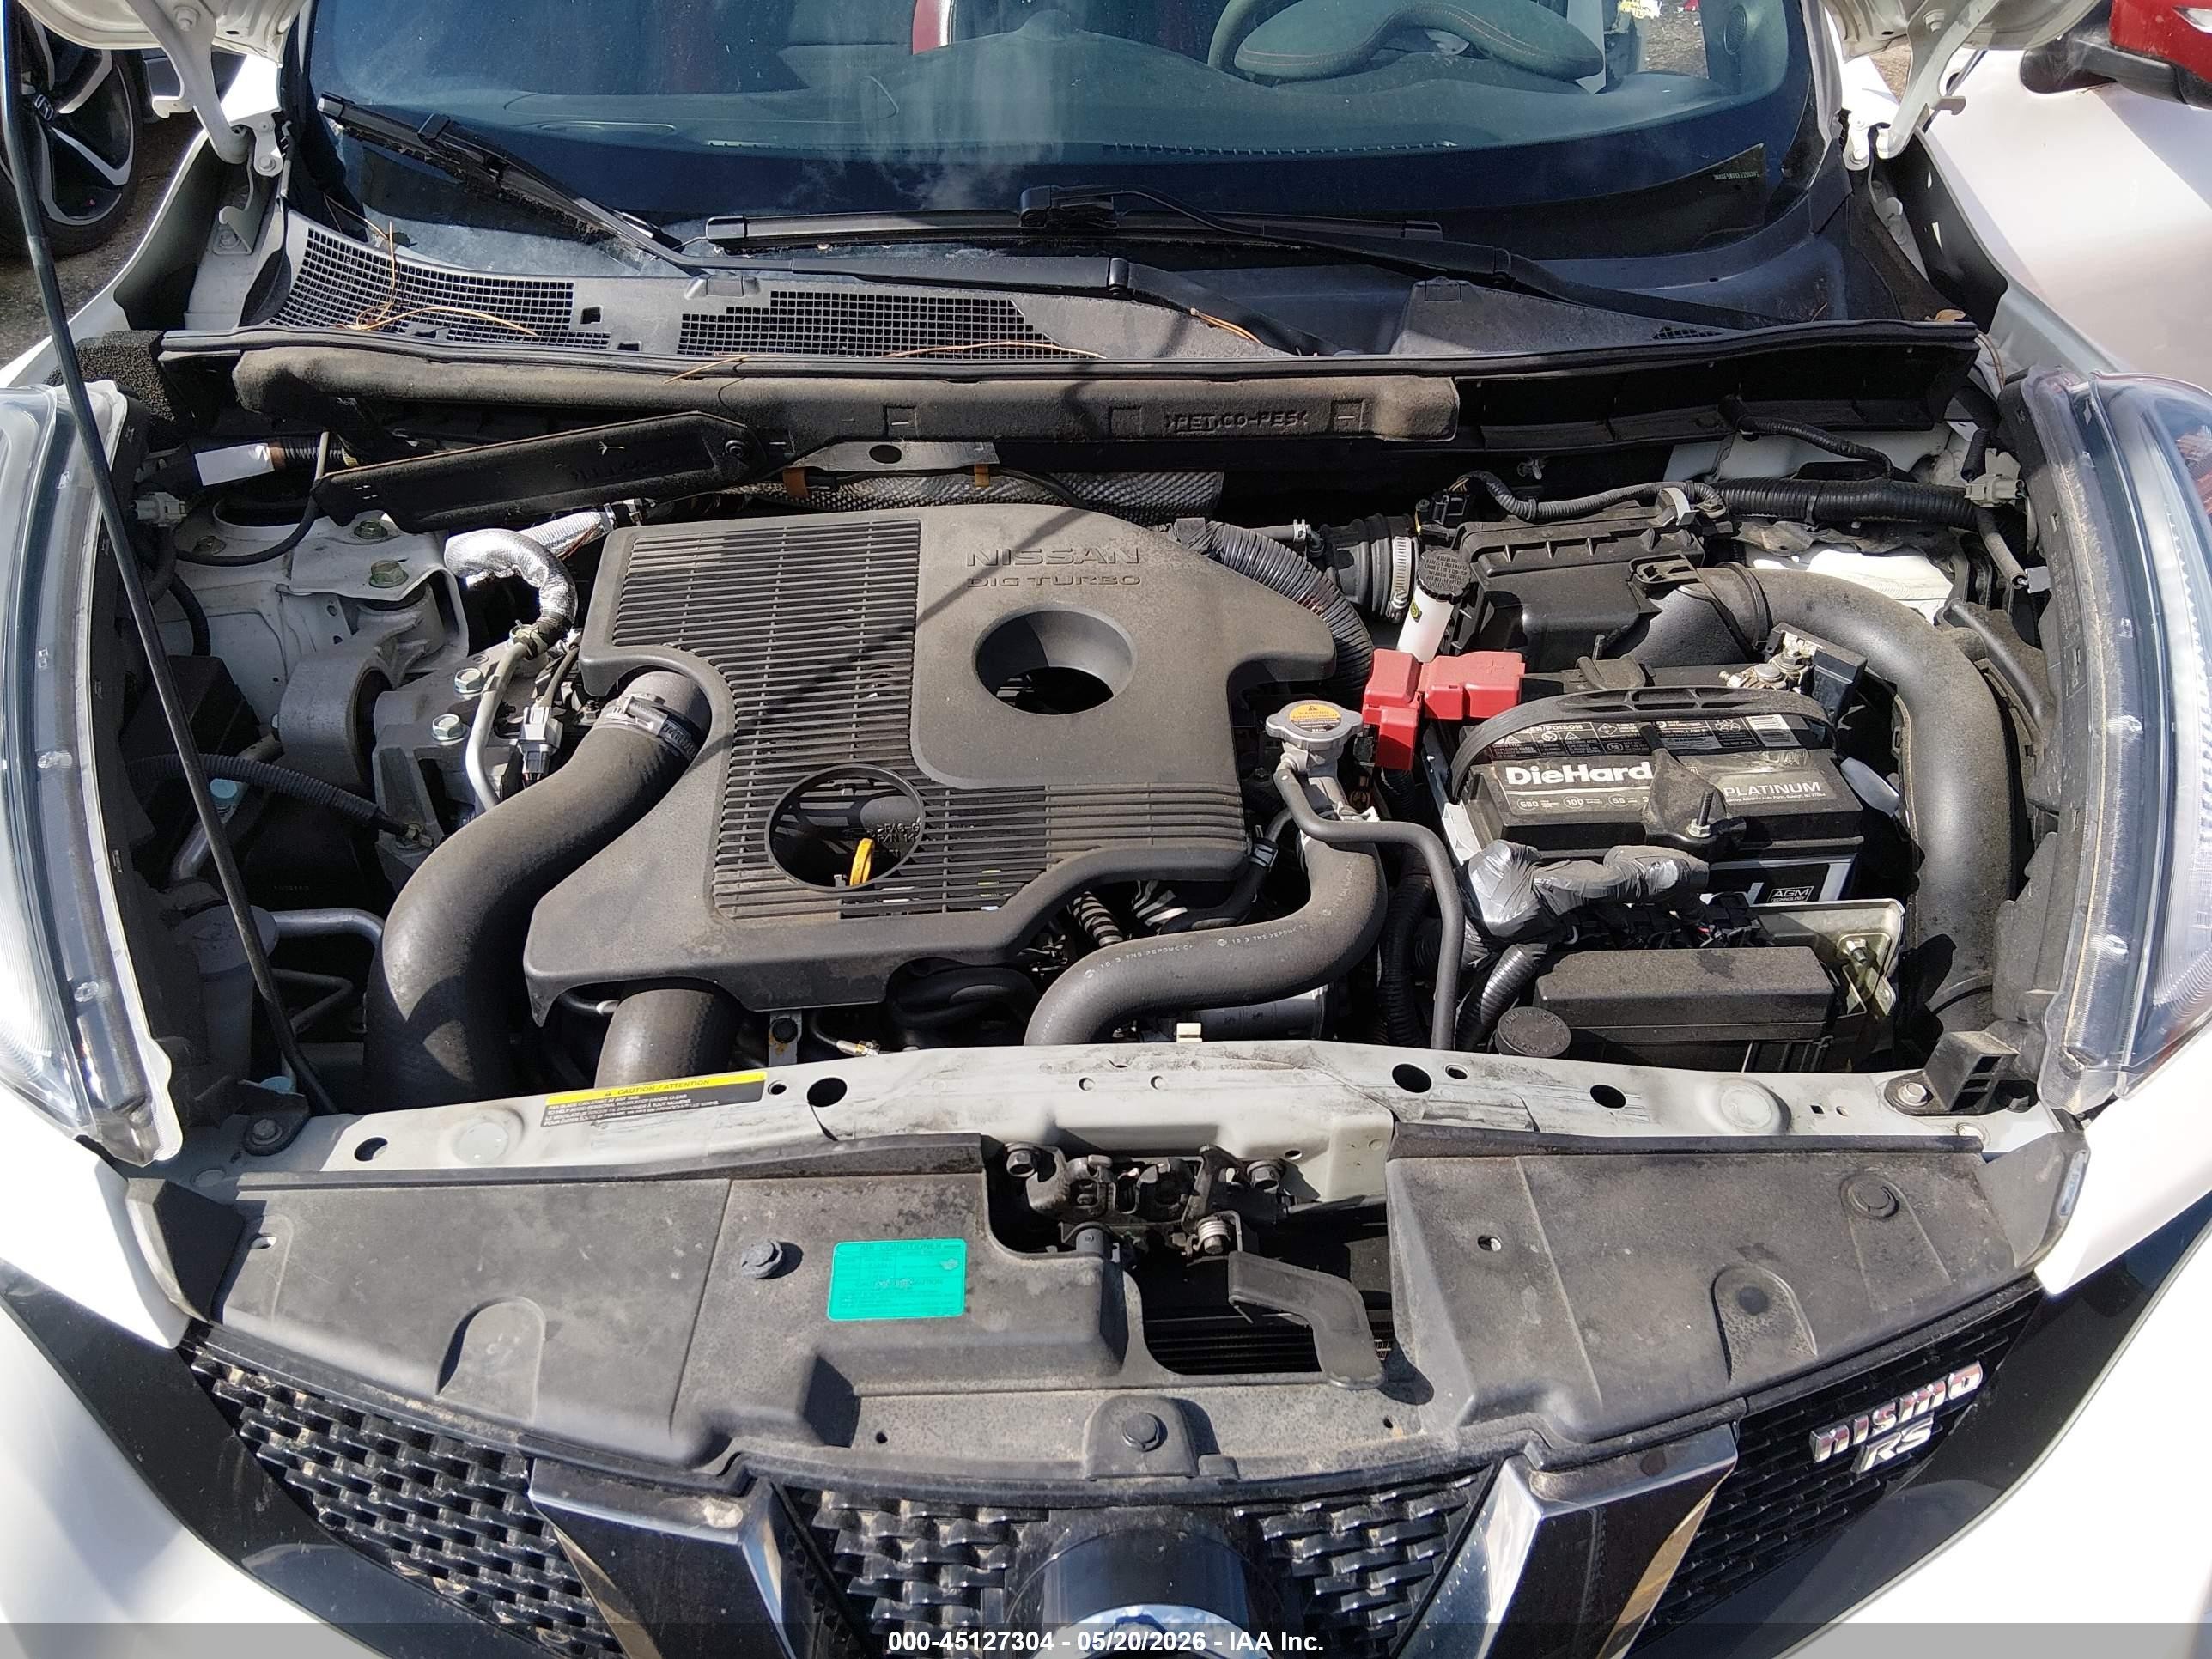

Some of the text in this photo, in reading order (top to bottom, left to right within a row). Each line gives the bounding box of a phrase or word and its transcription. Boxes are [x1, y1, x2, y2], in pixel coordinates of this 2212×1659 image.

[966, 548, 1140, 568] NISSAN
[967, 575, 1141, 588] DIG TURBO
[1505, 762, 1654, 785] DieHard
[1723, 781, 1822, 797] PLATINUM
[1772, 888, 1809, 898] AGM
[617, 1085, 657, 1096] CAUTION
[662, 1079, 710, 1090] ATTENTION
[1850, 1413, 1934, 1474] RS
